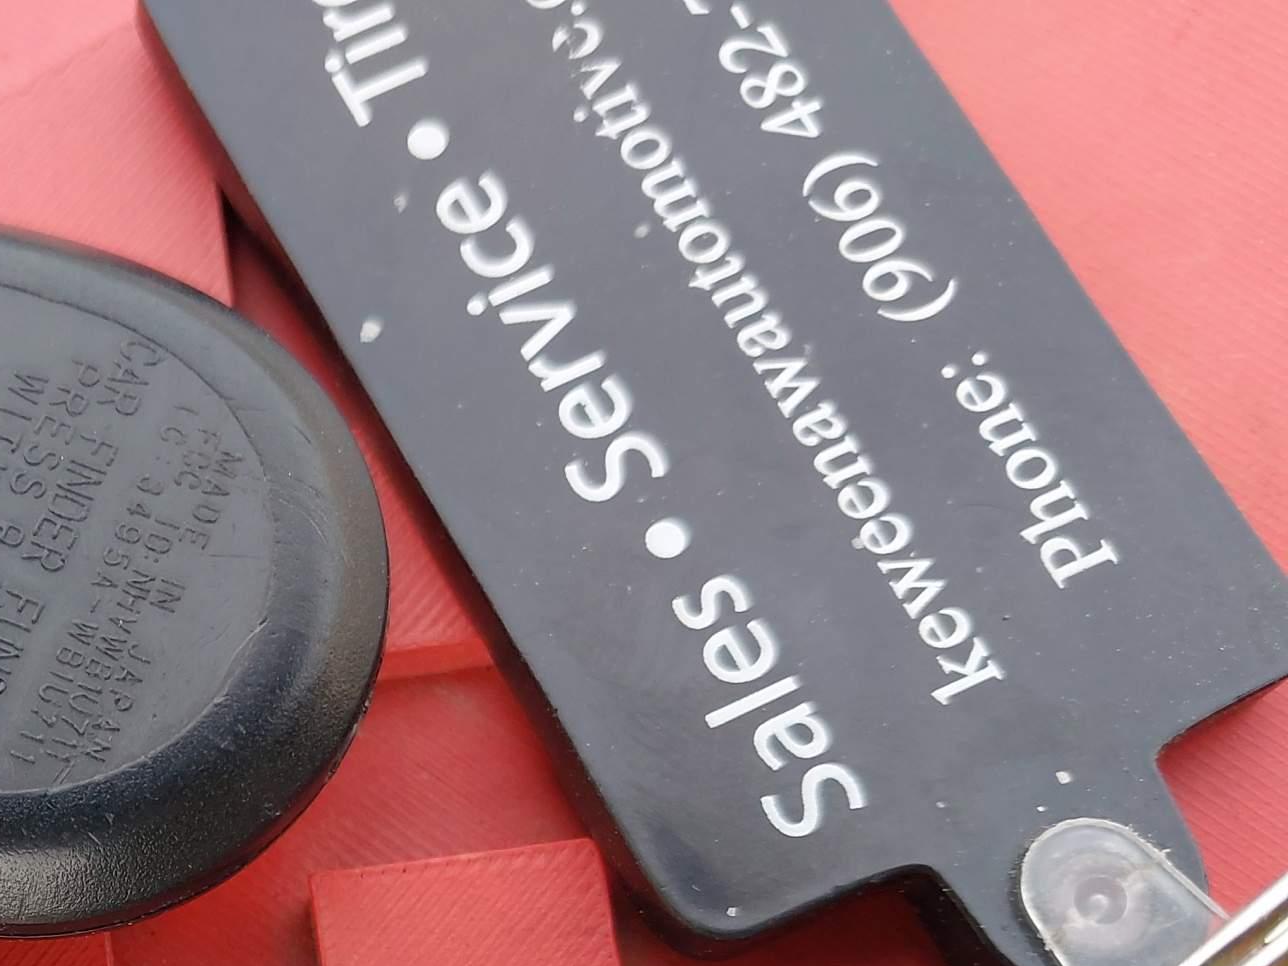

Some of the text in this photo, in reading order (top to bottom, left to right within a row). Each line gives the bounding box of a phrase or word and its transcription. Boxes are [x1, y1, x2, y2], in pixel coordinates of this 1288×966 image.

[95, 339, 166, 417] CAR
[524, 0, 1004, 705] keweenawautomotive.
[684, 0, 1120, 588] Phone: (906) 482-
[7, 359, 101, 503] PRESS
[21, 434, 117, 574] FINDER
[172, 427, 222, 493] FCC
[314, 0, 867, 837] Sales Service Tir
[83, 449, 243, 763] MADE IN JAPAN
